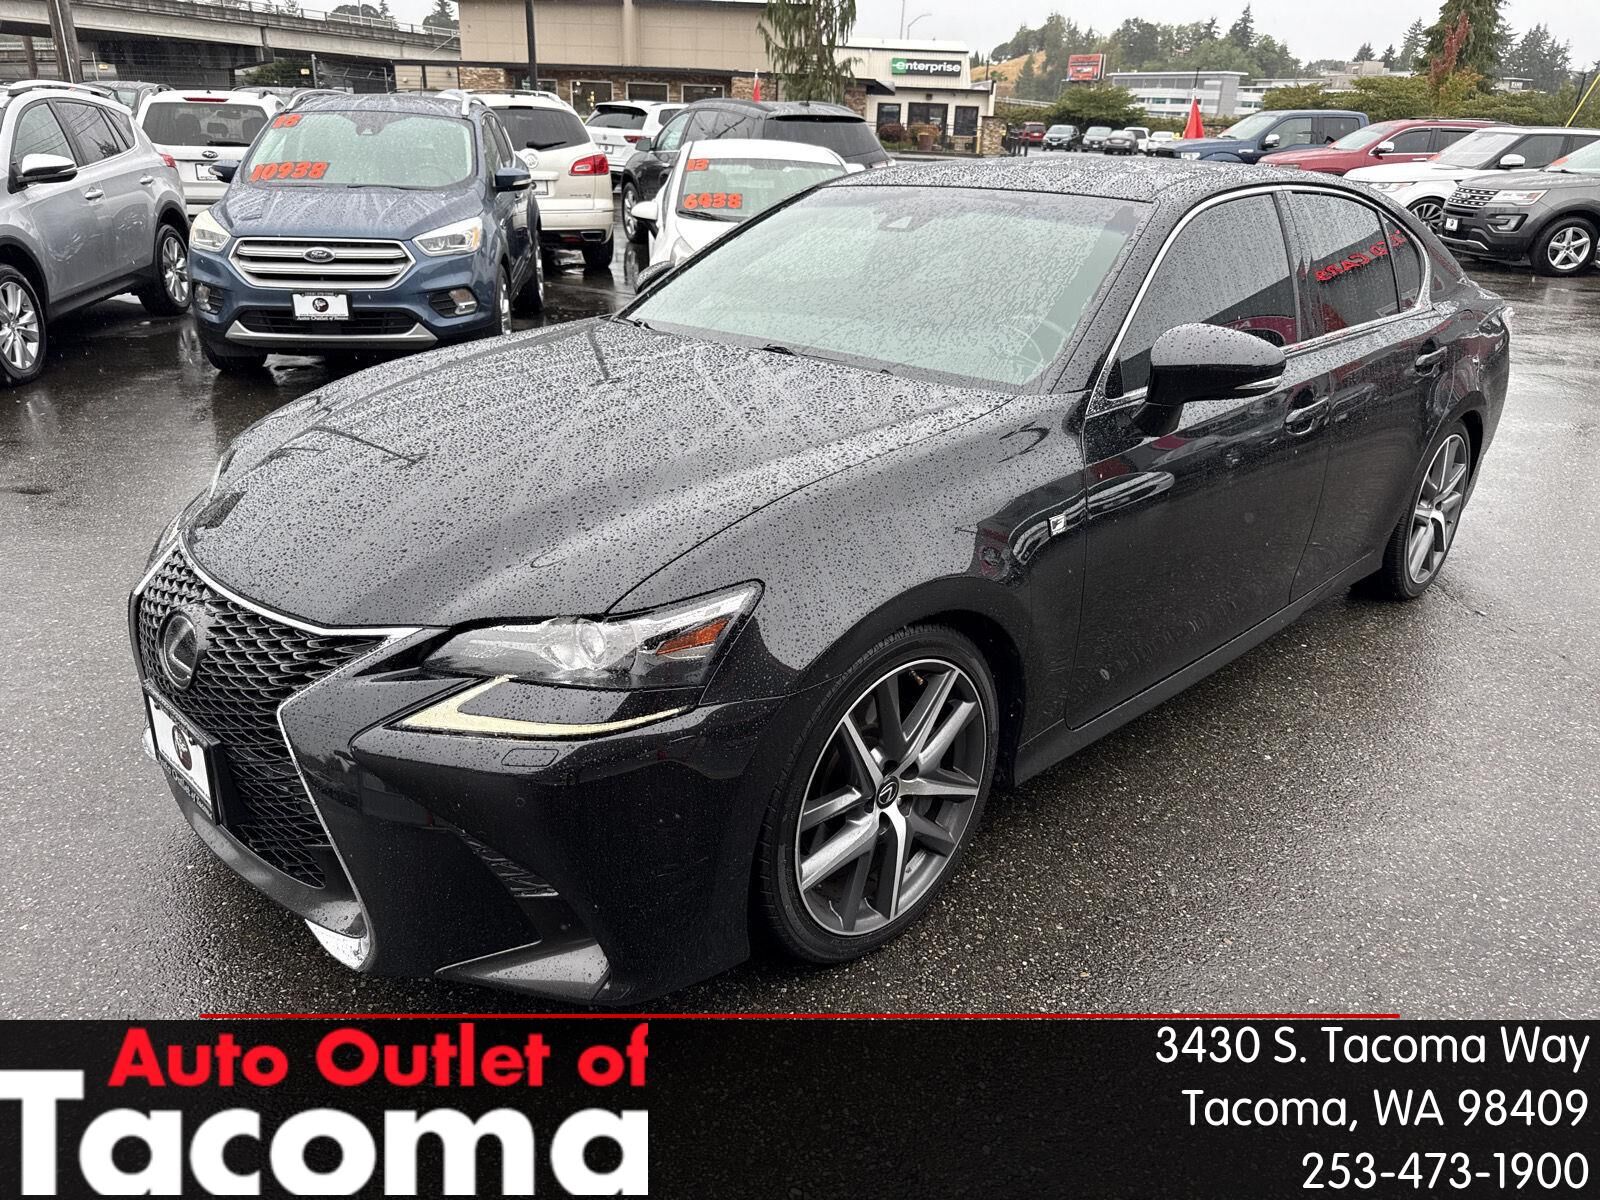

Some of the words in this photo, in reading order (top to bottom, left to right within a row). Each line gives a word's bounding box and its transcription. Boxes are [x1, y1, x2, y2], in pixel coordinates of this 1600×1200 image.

[894, 61, 961, 74] enterprise
[272, 113, 304, 129] 18
[249, 161, 329, 183] 10938
[686, 158, 710, 172] 13
